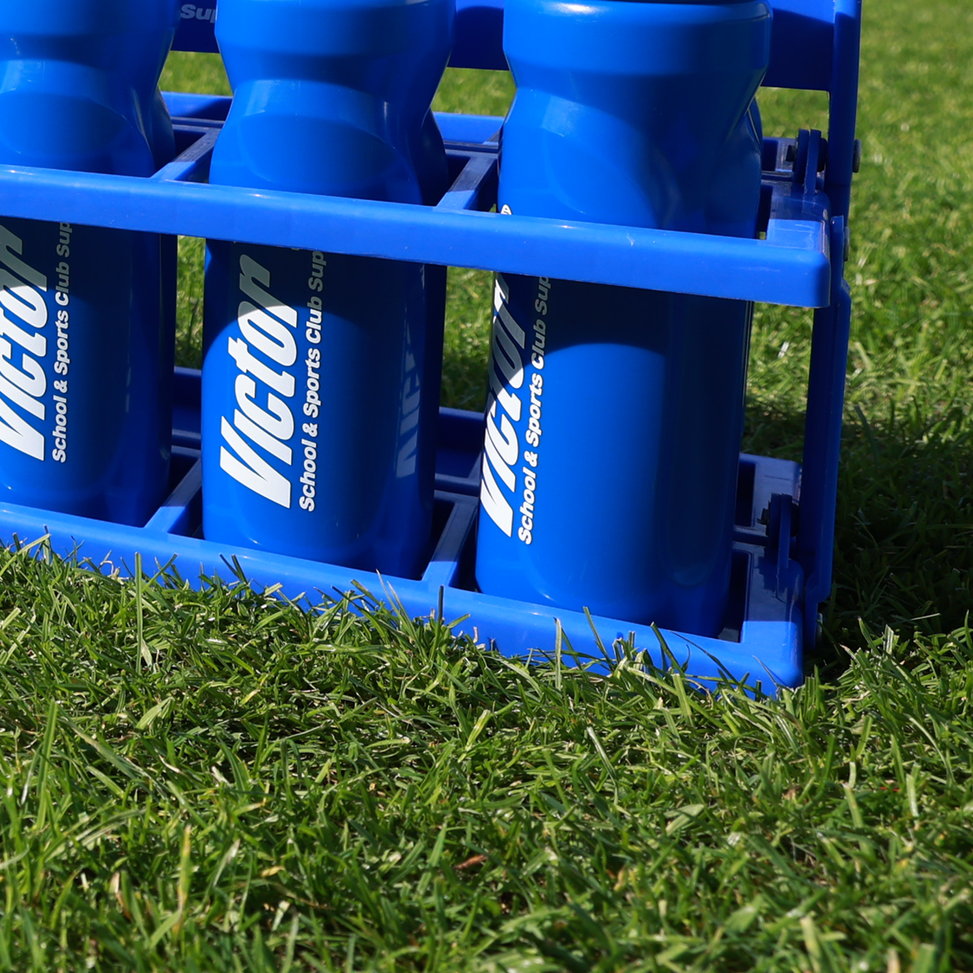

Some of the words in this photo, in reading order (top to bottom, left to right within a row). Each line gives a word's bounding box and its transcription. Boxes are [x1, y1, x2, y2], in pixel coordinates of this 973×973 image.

[55, 261, 70, 307] Club
[54, 310, 71, 376] Sports
[305, 296, 323, 344] Club
[531, 319, 547, 370] Club
[54, 380, 67, 394] &
[219, 254, 298, 509] Victor
[303, 348, 321, 418] Sports
[480, 272, 526, 537] Victor
[525, 373, 544, 448] Sports
[52, 395, 68, 463] School
[302, 422, 318, 437] &
[524, 451, 538, 468] &
[299, 439, 318, 512] School
[518, 467, 537, 545] School
